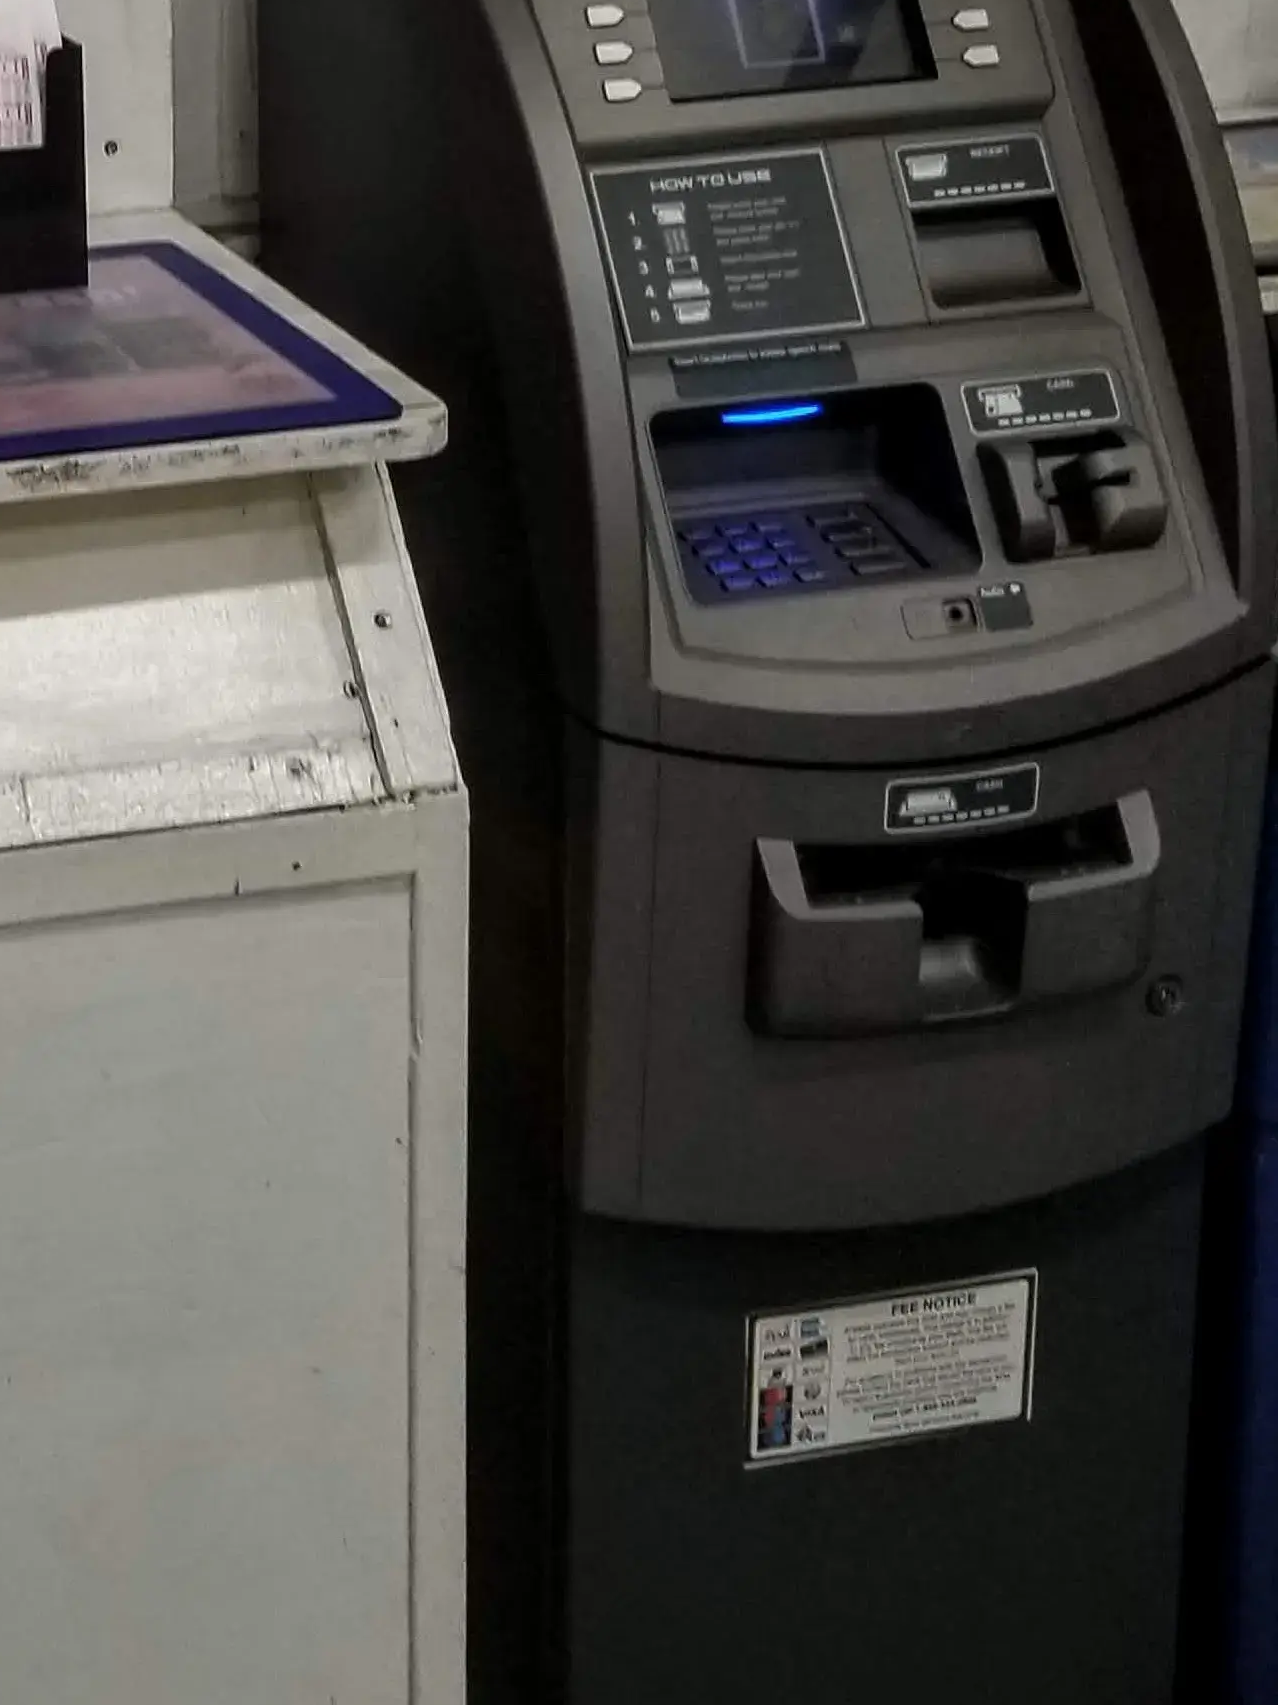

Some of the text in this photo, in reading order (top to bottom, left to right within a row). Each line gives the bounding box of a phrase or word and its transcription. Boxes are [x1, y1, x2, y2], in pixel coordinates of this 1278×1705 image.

[649, 176, 693, 193] HOW
[696, 172, 726, 188] TO
[891, 1291, 977, 1316] FEE NOTICE
